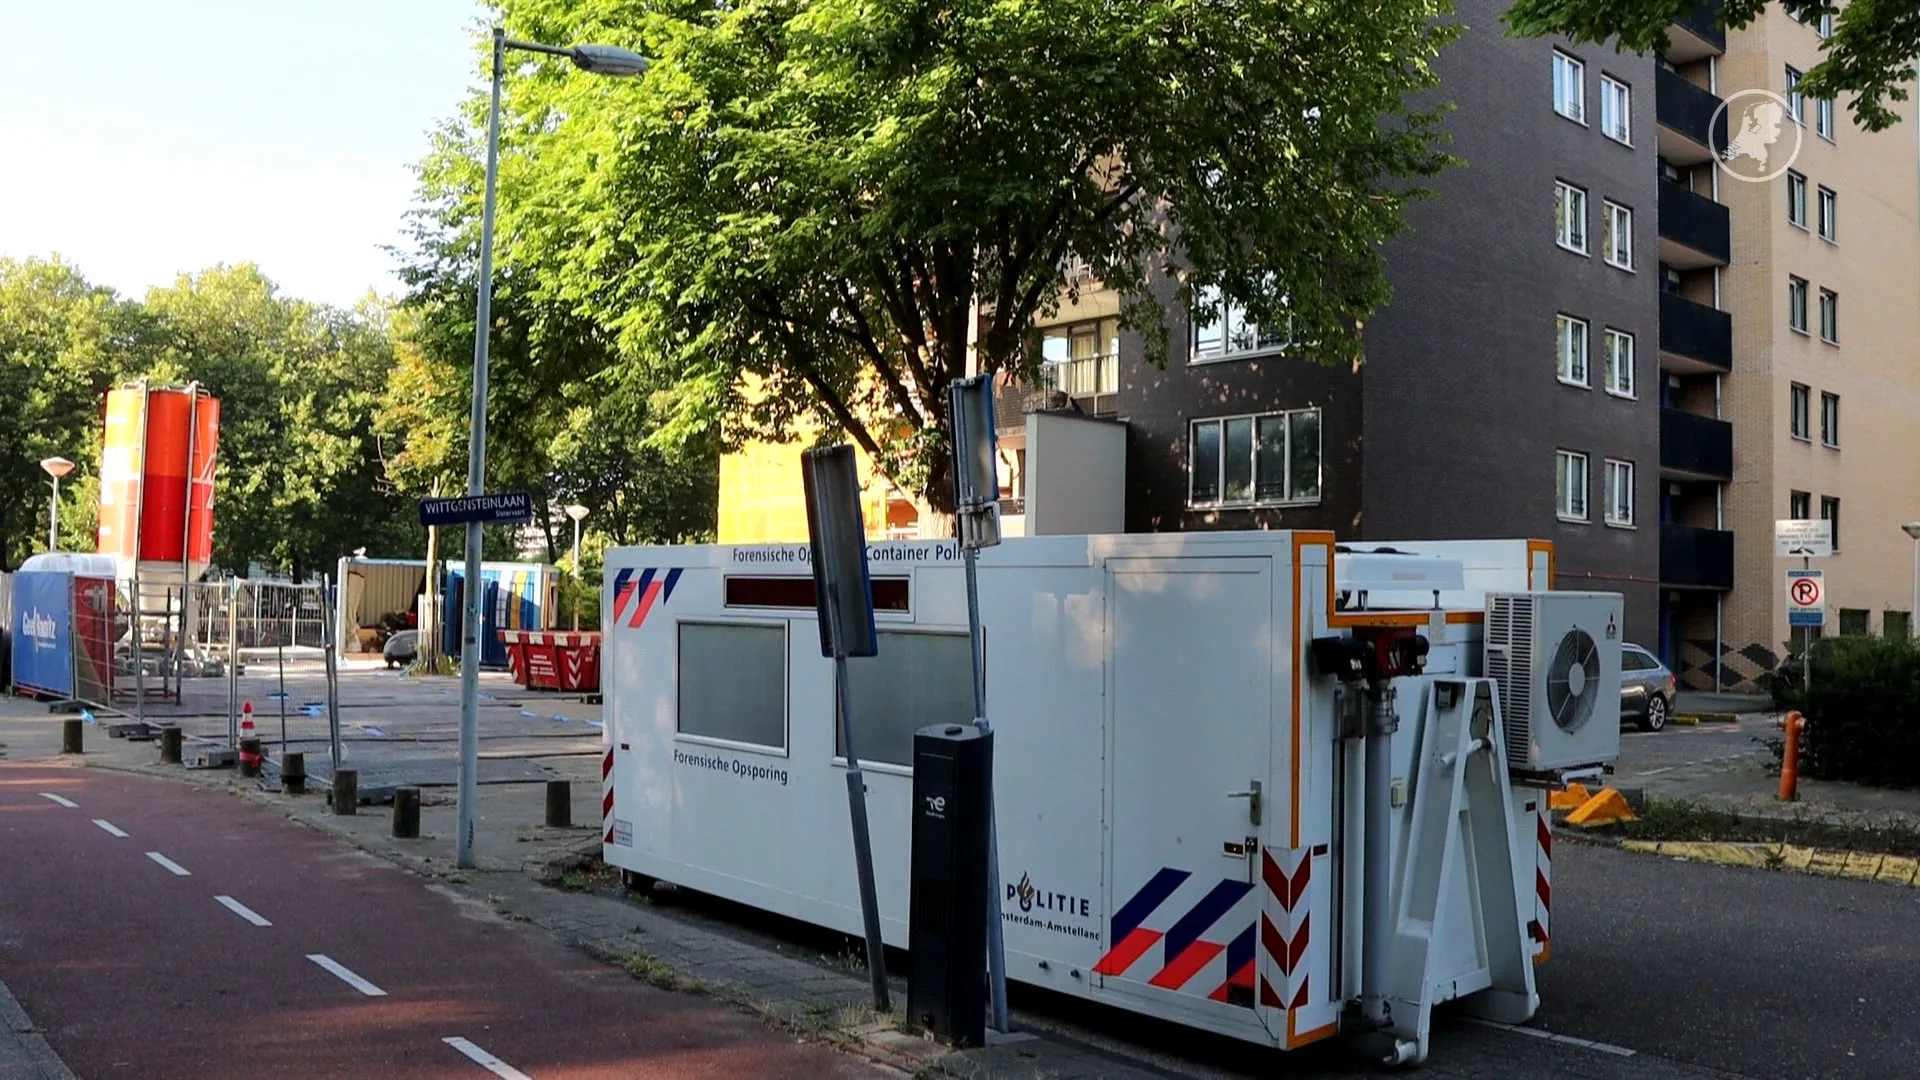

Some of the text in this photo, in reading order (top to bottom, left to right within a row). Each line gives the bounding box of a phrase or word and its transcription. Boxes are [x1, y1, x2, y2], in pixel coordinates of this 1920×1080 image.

[425, 495, 525, 515] WITTGENSTEINLAAN
[733, 546, 794, 563] Forensische
[865, 544, 929, 561] Container
[935, 543, 981, 561] Polie
[673, 749, 788, 786] Forensische Opsporing
[1006, 883, 1090, 918] POLITIE
[1001, 912, 1100, 942] sterdam-Amstellan
